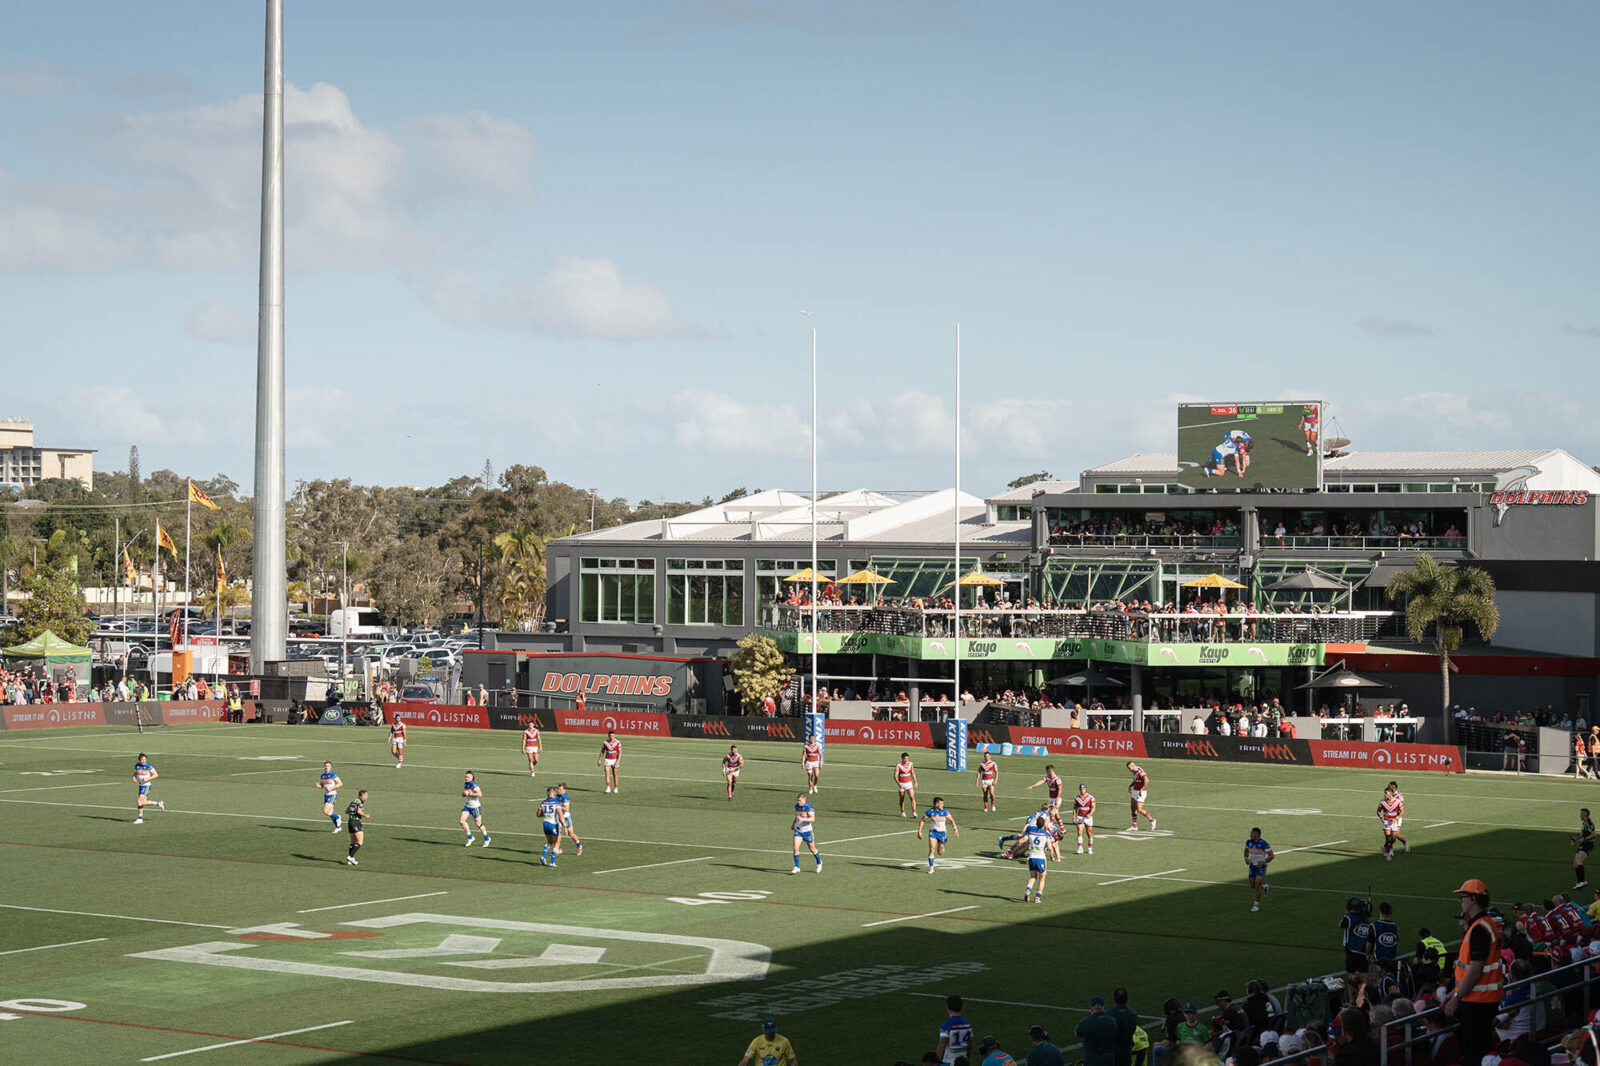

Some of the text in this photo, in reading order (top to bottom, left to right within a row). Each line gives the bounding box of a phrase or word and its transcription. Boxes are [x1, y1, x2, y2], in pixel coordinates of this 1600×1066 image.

[1490, 490, 1589, 505] DOLPHINS
[968, 641, 997, 656] Kayo
[1054, 641, 1082, 656] Kayo
[1200, 646, 1229, 663] Kayo
[1287, 646, 1316, 663] Kayo
[541, 672, 673, 696] DOLPHINS
[417, 712, 425, 720] ON
[444, 712, 480, 724] LiSTNR
[564, 718, 585, 726] STREAM
[591, 718, 600, 726] ON
[620, 720, 660, 731] LiSTNR
[846, 729, 855, 737] ON
[878, 729, 920, 740] LiSTNR
[948, 722, 957, 769] KINGS
[960, 722, 968, 768] KINGS
[1021, 736, 1046, 744] STREAM
[1053, 737, 1062, 746] ON
[1087, 739, 1134, 750] LiSTNR
[1322, 750, 1448, 764] STREAM IT ON LiSTNR
[543, 805, 554, 814] 15
[1033, 836, 1041, 846] 6
[666, 891, 757, 906] 40
[952, 1030, 972, 1047] 14
